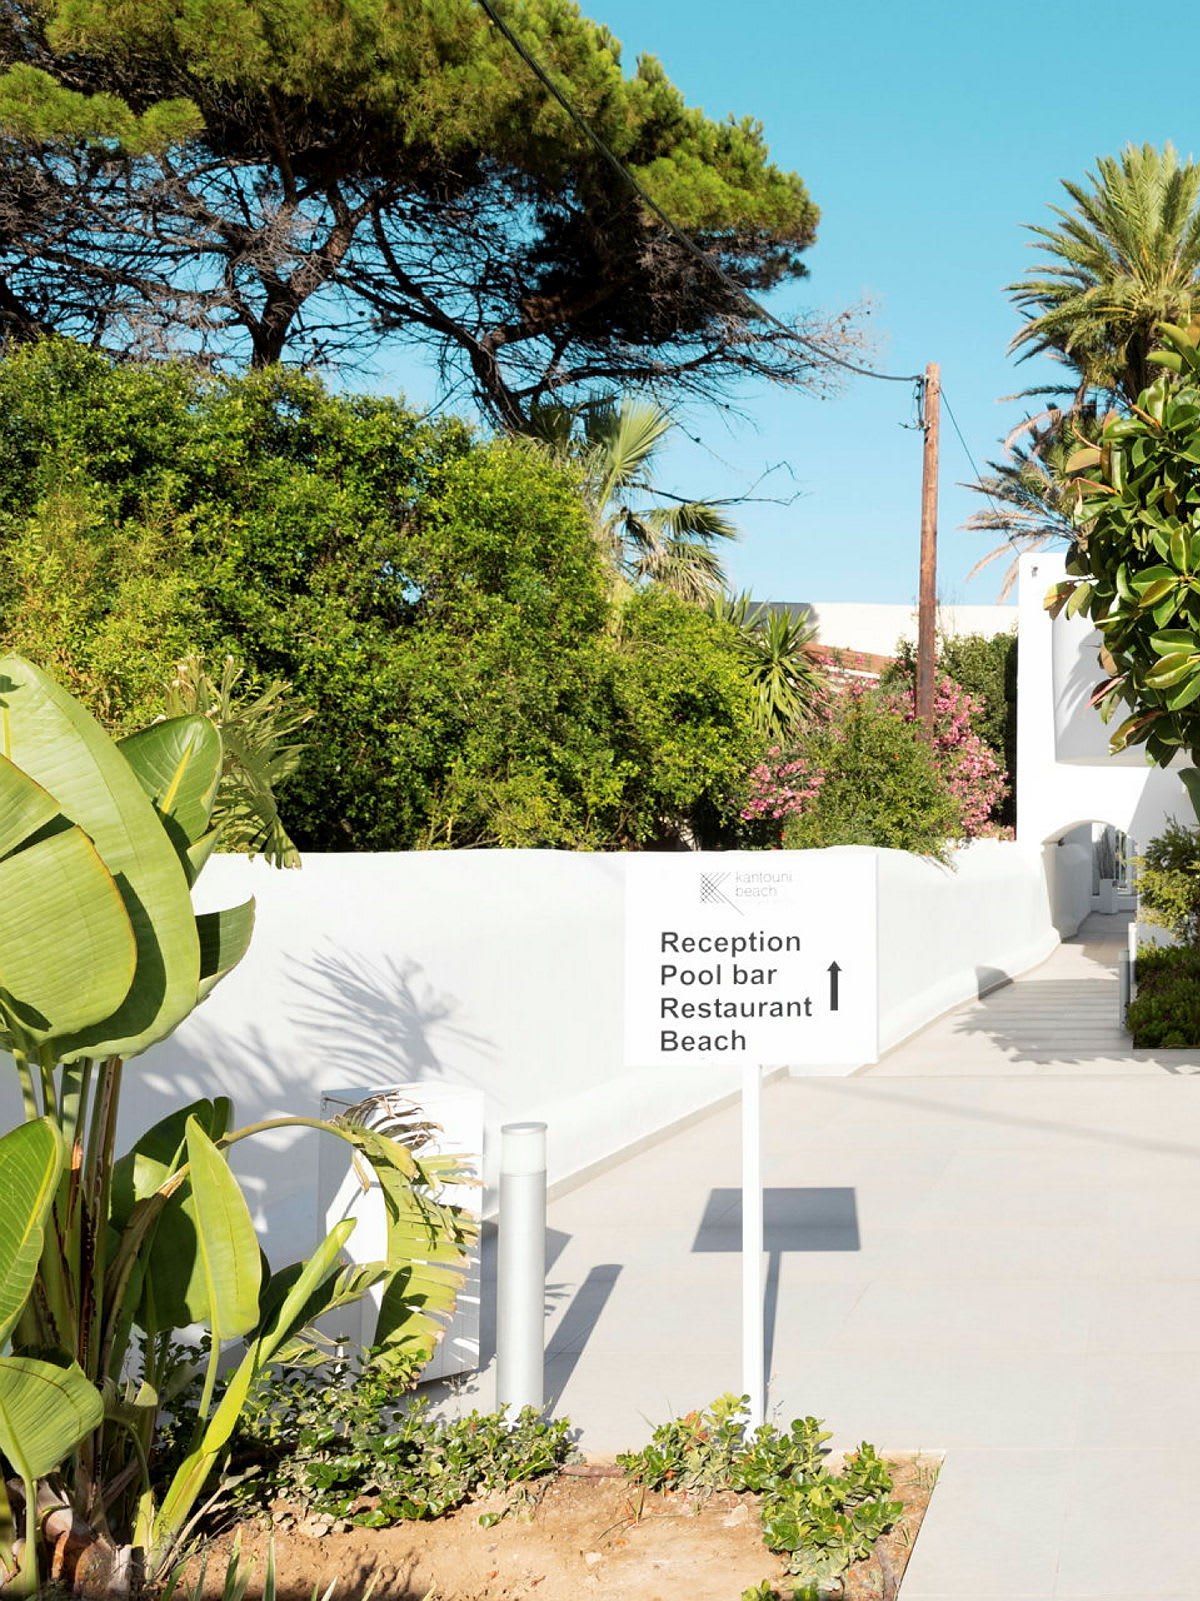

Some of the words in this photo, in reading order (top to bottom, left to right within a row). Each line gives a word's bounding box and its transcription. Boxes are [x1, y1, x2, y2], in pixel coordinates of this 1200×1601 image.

[735, 871, 793, 883] kantouni
[735, 885, 777, 897] beach
[661, 931, 801, 957] Reception
[661, 964, 721, 986] Pool
[733, 964, 778, 985] bar
[661, 997, 813, 1019] Restaurant
[661, 1030, 746, 1051] Beach
